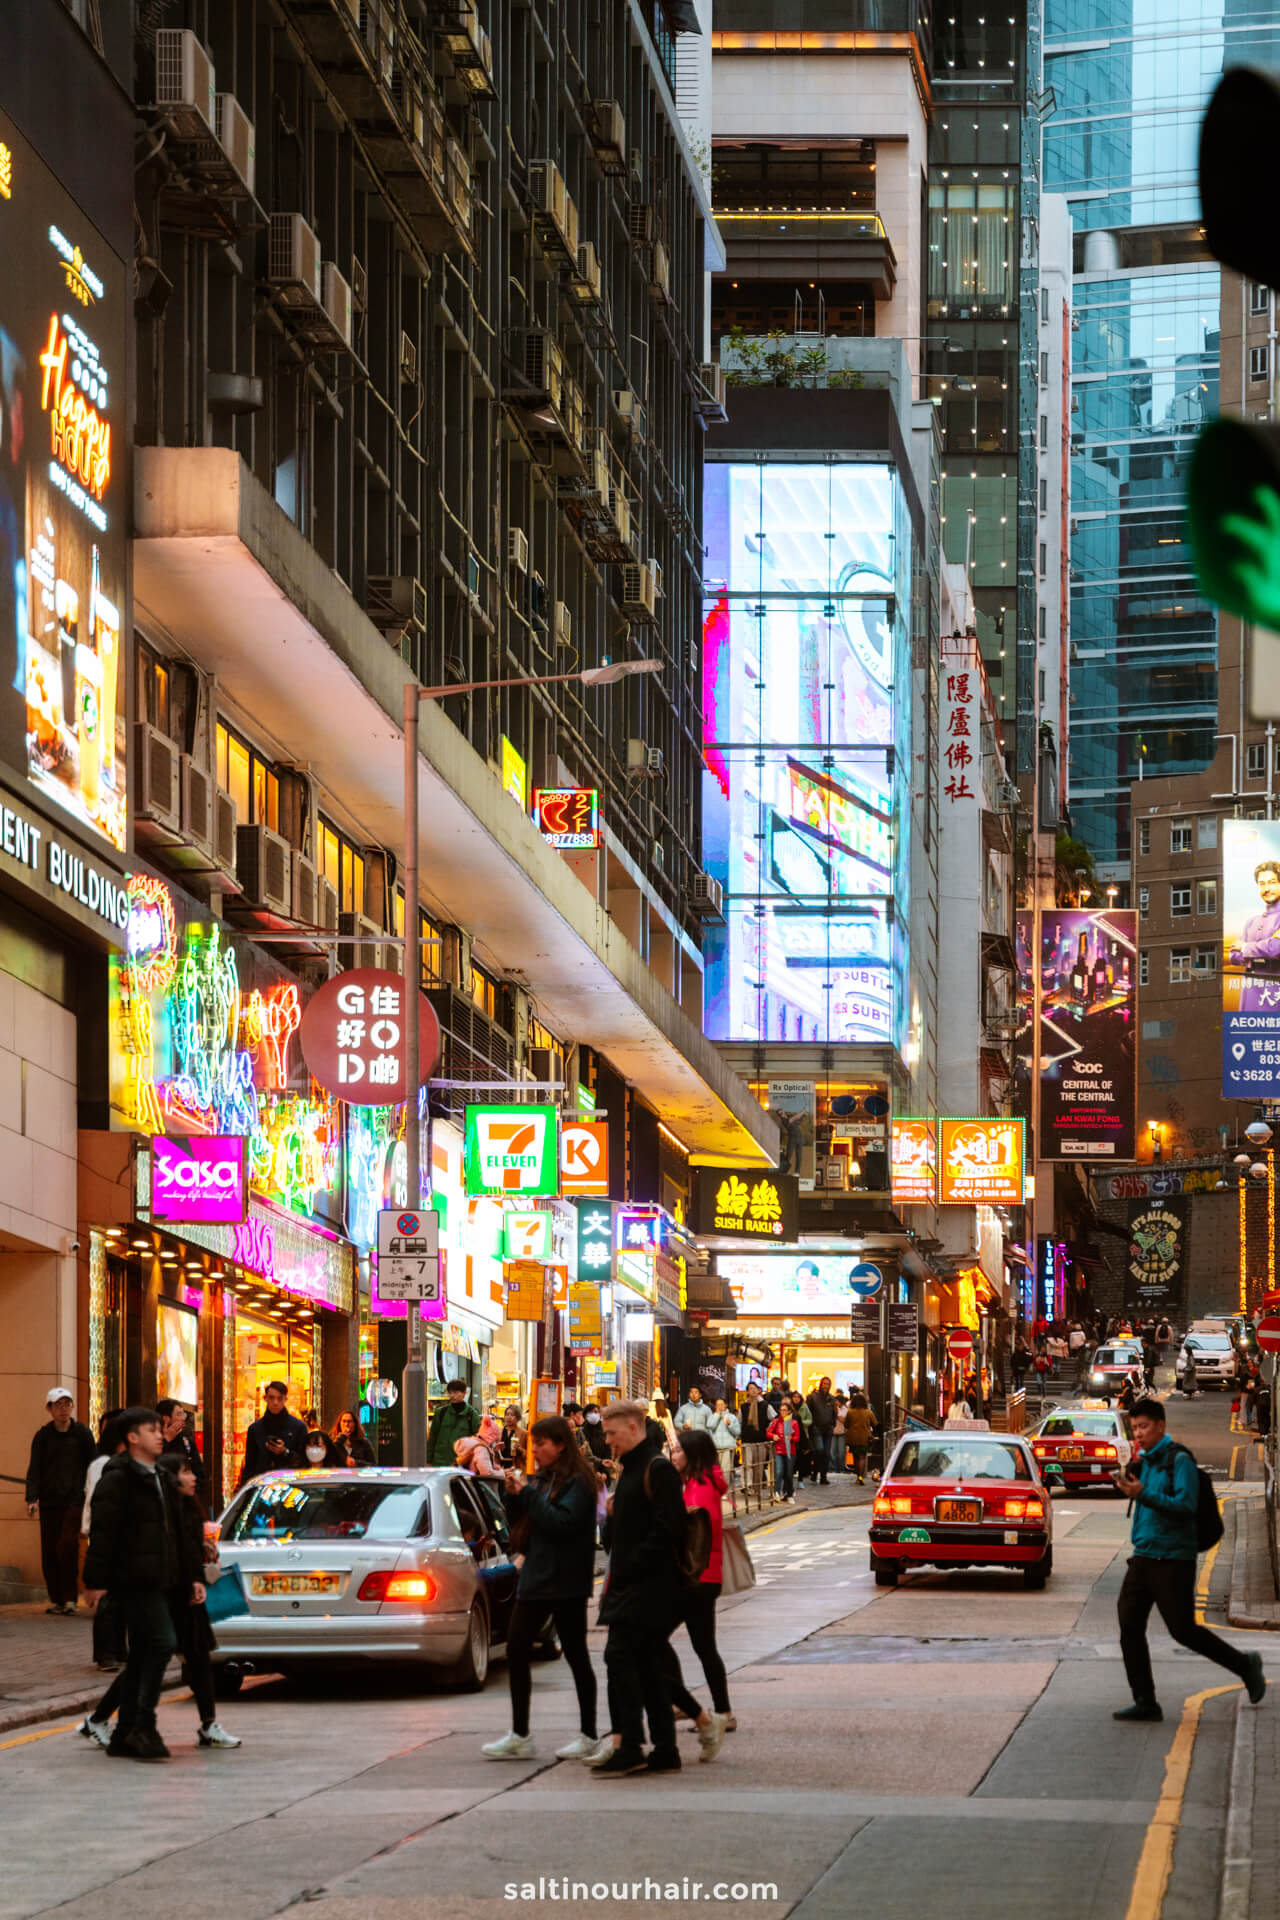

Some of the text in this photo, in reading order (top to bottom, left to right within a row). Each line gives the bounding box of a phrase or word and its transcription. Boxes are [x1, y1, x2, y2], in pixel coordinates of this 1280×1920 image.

[39, 312, 111, 480] Happy
[944, 673, 976, 803] 隱廬佛社
[50, 841, 128, 929] BUILDING
[1242, 1070, 1273, 1081] 3628
[1062, 1080, 1113, 1090] CENTRAL OF
[1060, 1092, 1115, 1102] THE CENTRAL
[1097, 1115, 1120, 1123] FONG
[566, 1139, 597, 1172] K
[1147, 1210, 1161, 1222] ALL
[714, 1216, 772, 1233] SUSHI RAKU
[581, 1210, 612, 1269] 文華
[417, 1260, 426, 1274] 7
[1129, 1260, 1180, 1284] TAKE IT SLOW
[417, 1283, 435, 1297] 12
[1045, 1278, 1054, 1322] MUSIC
[746, 1327, 786, 1339] GREEN
[951, 1502, 966, 1513] UB
[943, 1511, 975, 1522] 4800
